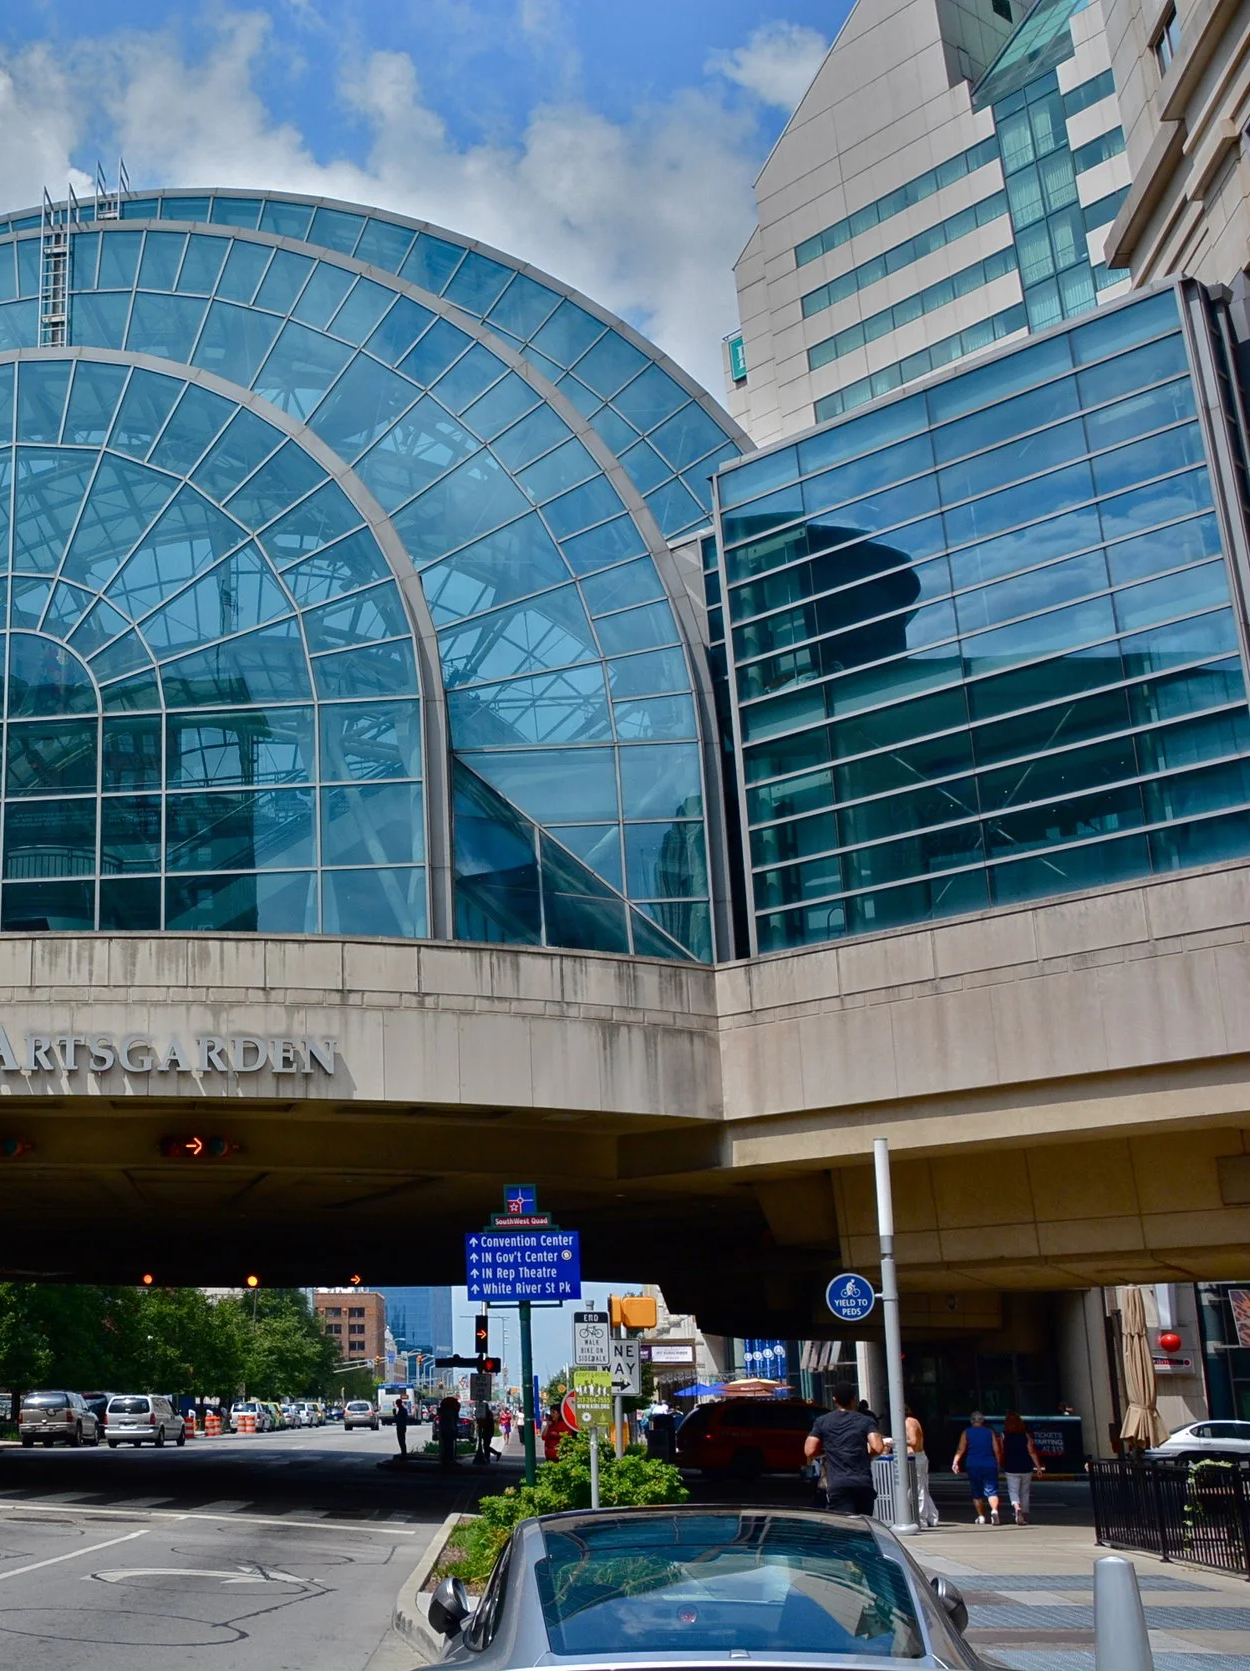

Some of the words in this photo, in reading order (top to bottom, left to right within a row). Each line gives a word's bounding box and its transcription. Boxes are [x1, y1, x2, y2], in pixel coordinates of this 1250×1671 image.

[495, 1218, 530, 1226] SouthWest
[531, 1217, 548, 1225] Quad
[480, 1235, 537, 1247] Convention
[540, 1235, 574, 1246] Center
[481, 1252, 492, 1263] IN
[496, 1252, 522, 1263] Gov't
[525, 1251, 558, 1262] Center
[482, 1268, 493, 1278] IN
[496, 1267, 515, 1281] Rep
[519, 1267, 557, 1278] Theatre
[483, 1282, 512, 1294] White
[516, 1282, 542, 1294] River
[545, 1282, 555, 1293] St
[559, 1281, 571, 1293] Pk
[834, 1299, 856, 1307] YIELD
[857, 1298, 868, 1306] TO
[583, 1314, 599, 1322] END
[842, 1308, 862, 1316] PEDS
[614, 1345, 634, 1357] NE
[602, 1363, 636, 1375] WAY
[1034, 1438, 1064, 1446] TARTING
